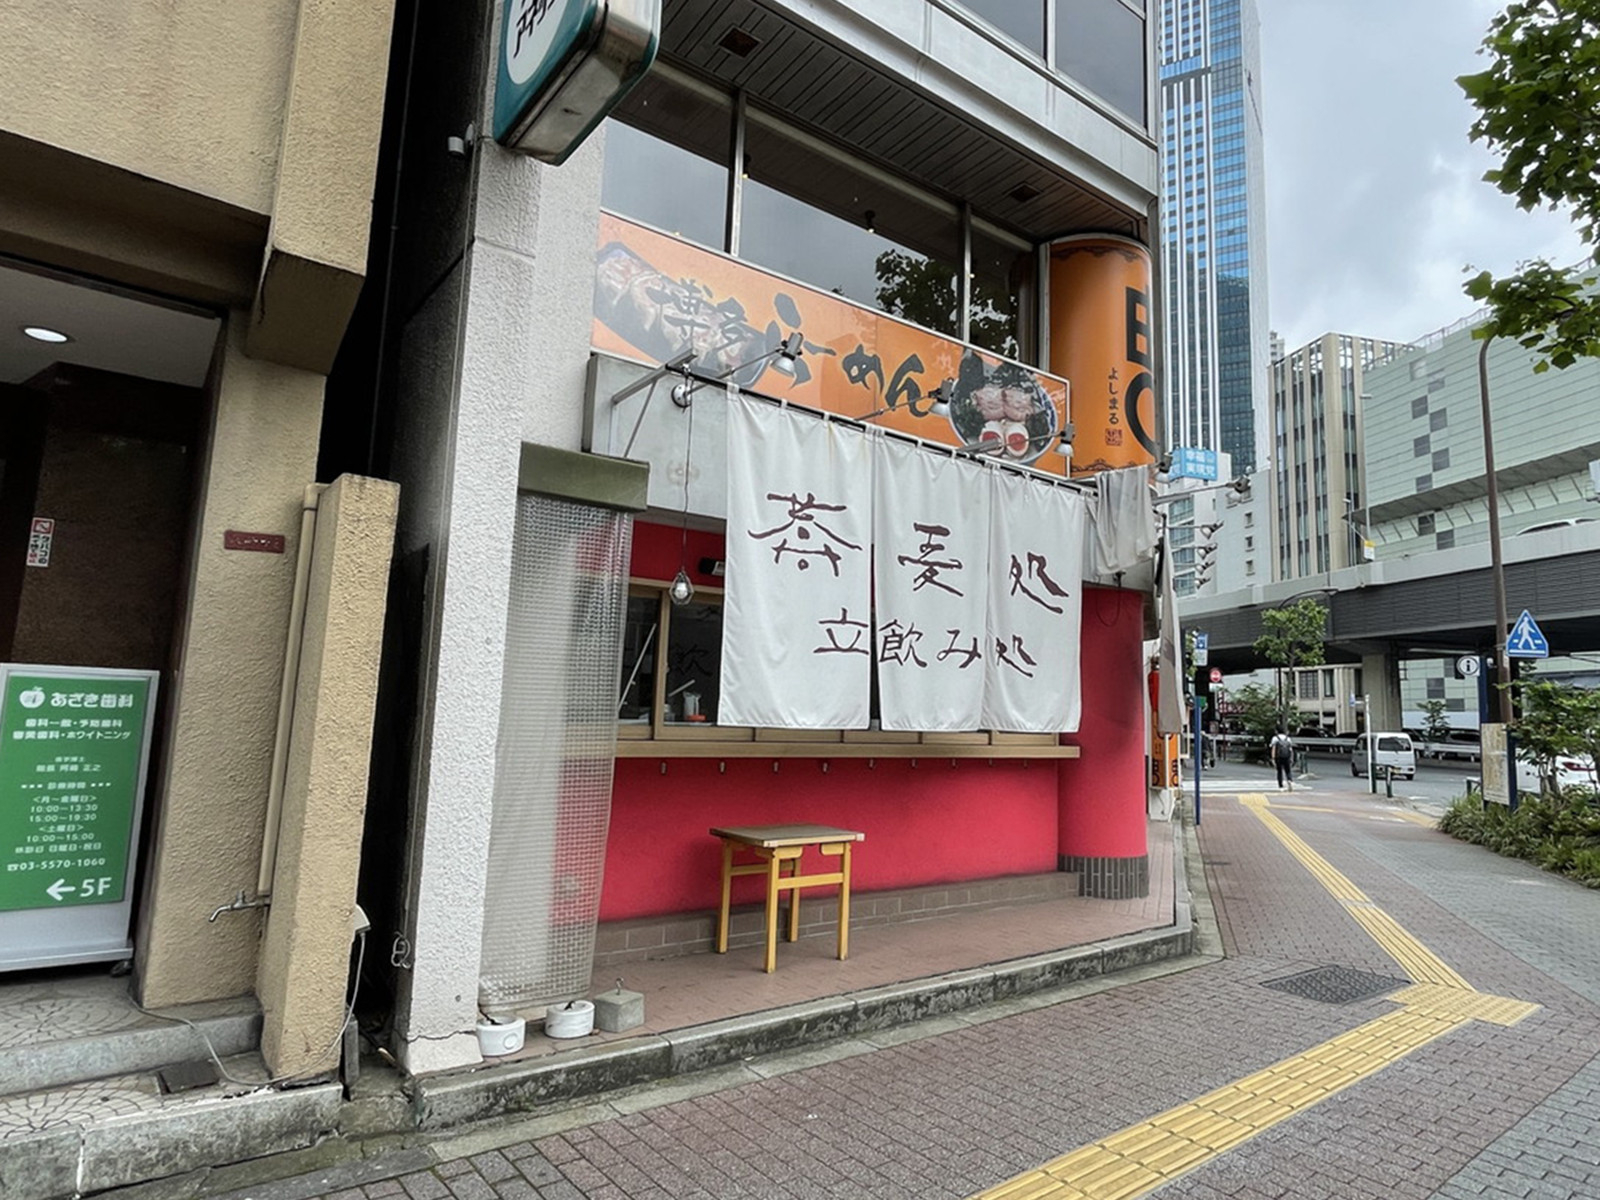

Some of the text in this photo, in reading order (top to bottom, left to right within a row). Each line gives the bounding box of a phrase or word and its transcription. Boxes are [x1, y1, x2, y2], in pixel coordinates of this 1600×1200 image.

[1107, 367, 1119, 425] よしまる
[812, 607, 1038, 678] 立飲み処
[79, 876, 112, 897] 5F
